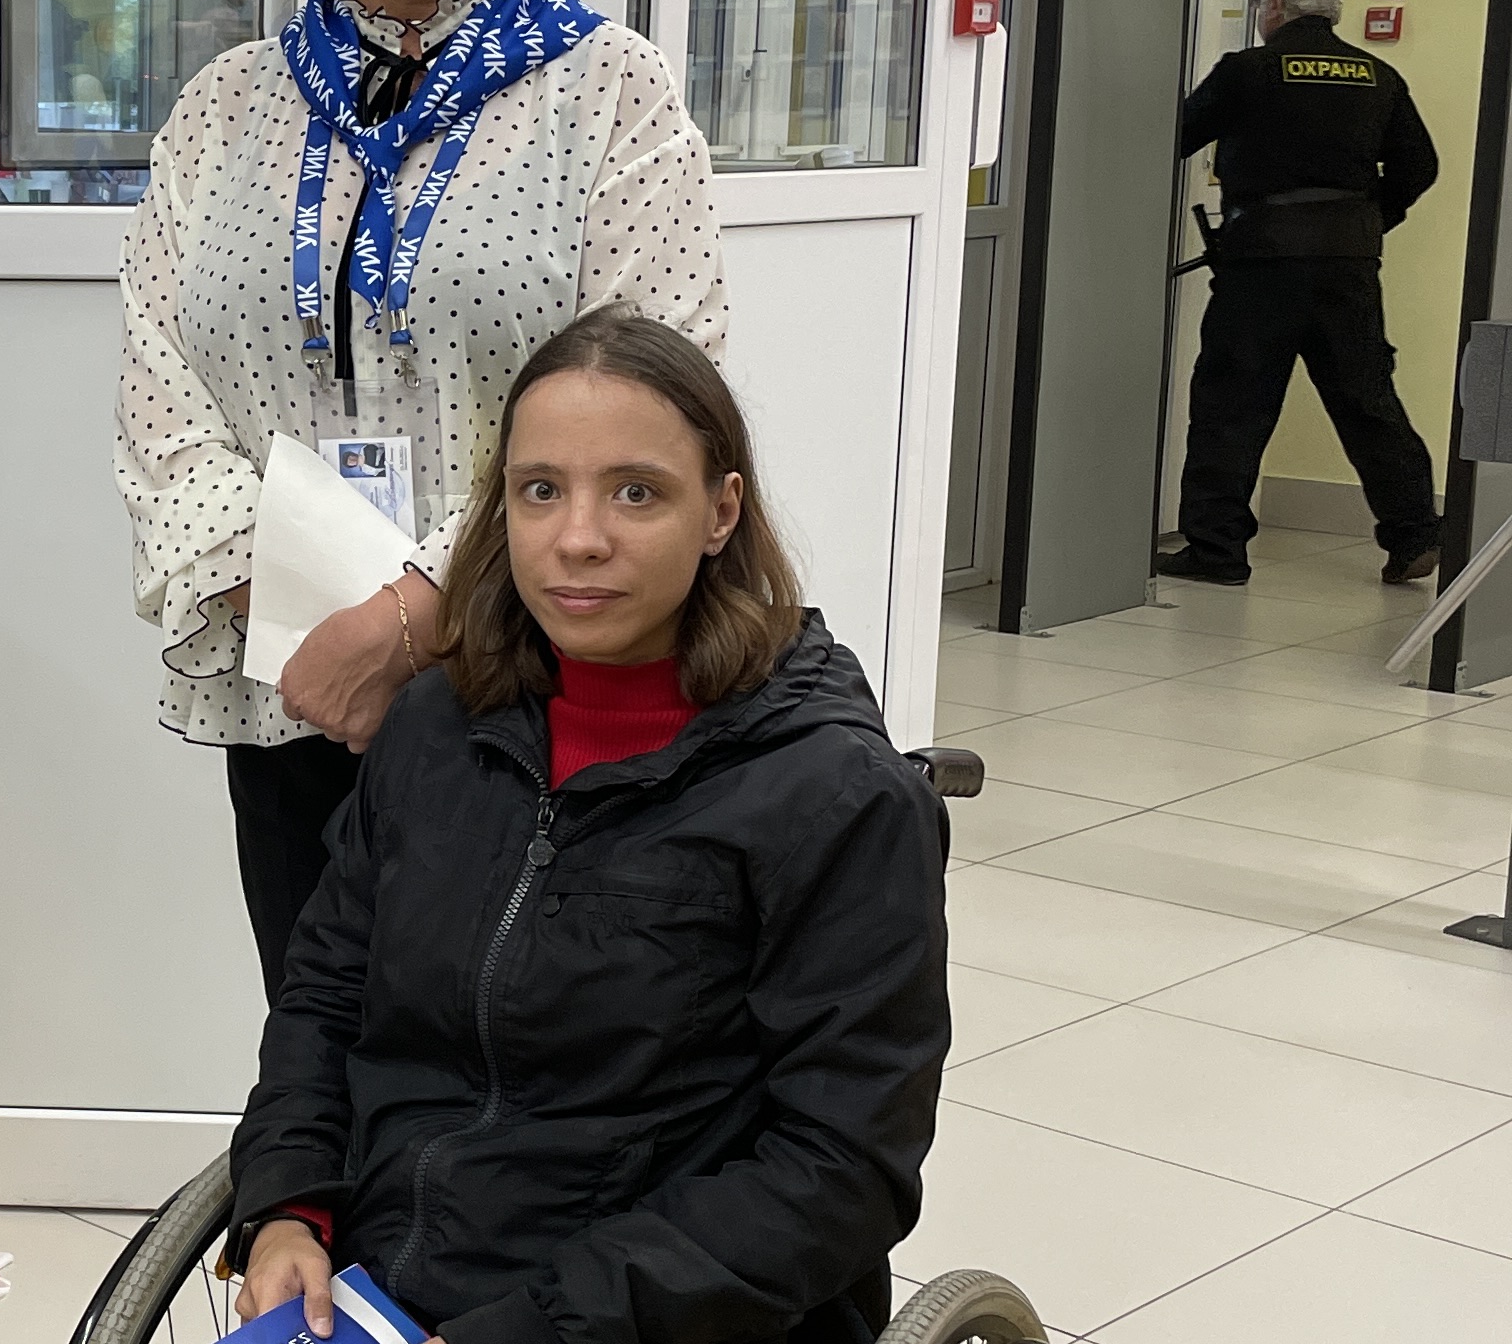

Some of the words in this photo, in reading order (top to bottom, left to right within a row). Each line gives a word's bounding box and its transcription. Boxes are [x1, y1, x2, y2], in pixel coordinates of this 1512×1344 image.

[445, 17, 485, 63] УИК
[481, 27, 507, 80] УИК
[303, 57, 334, 111] УИК
[1287, 60, 1373, 81] ОХРАНА
[301, 143, 328, 181] УИК
[414, 168, 453, 209] УИК
[295, 202, 319, 251] УИК
[353, 227, 385, 286] УИК
[390, 236, 422, 286] УИК
[295, 280, 320, 319] ИК
